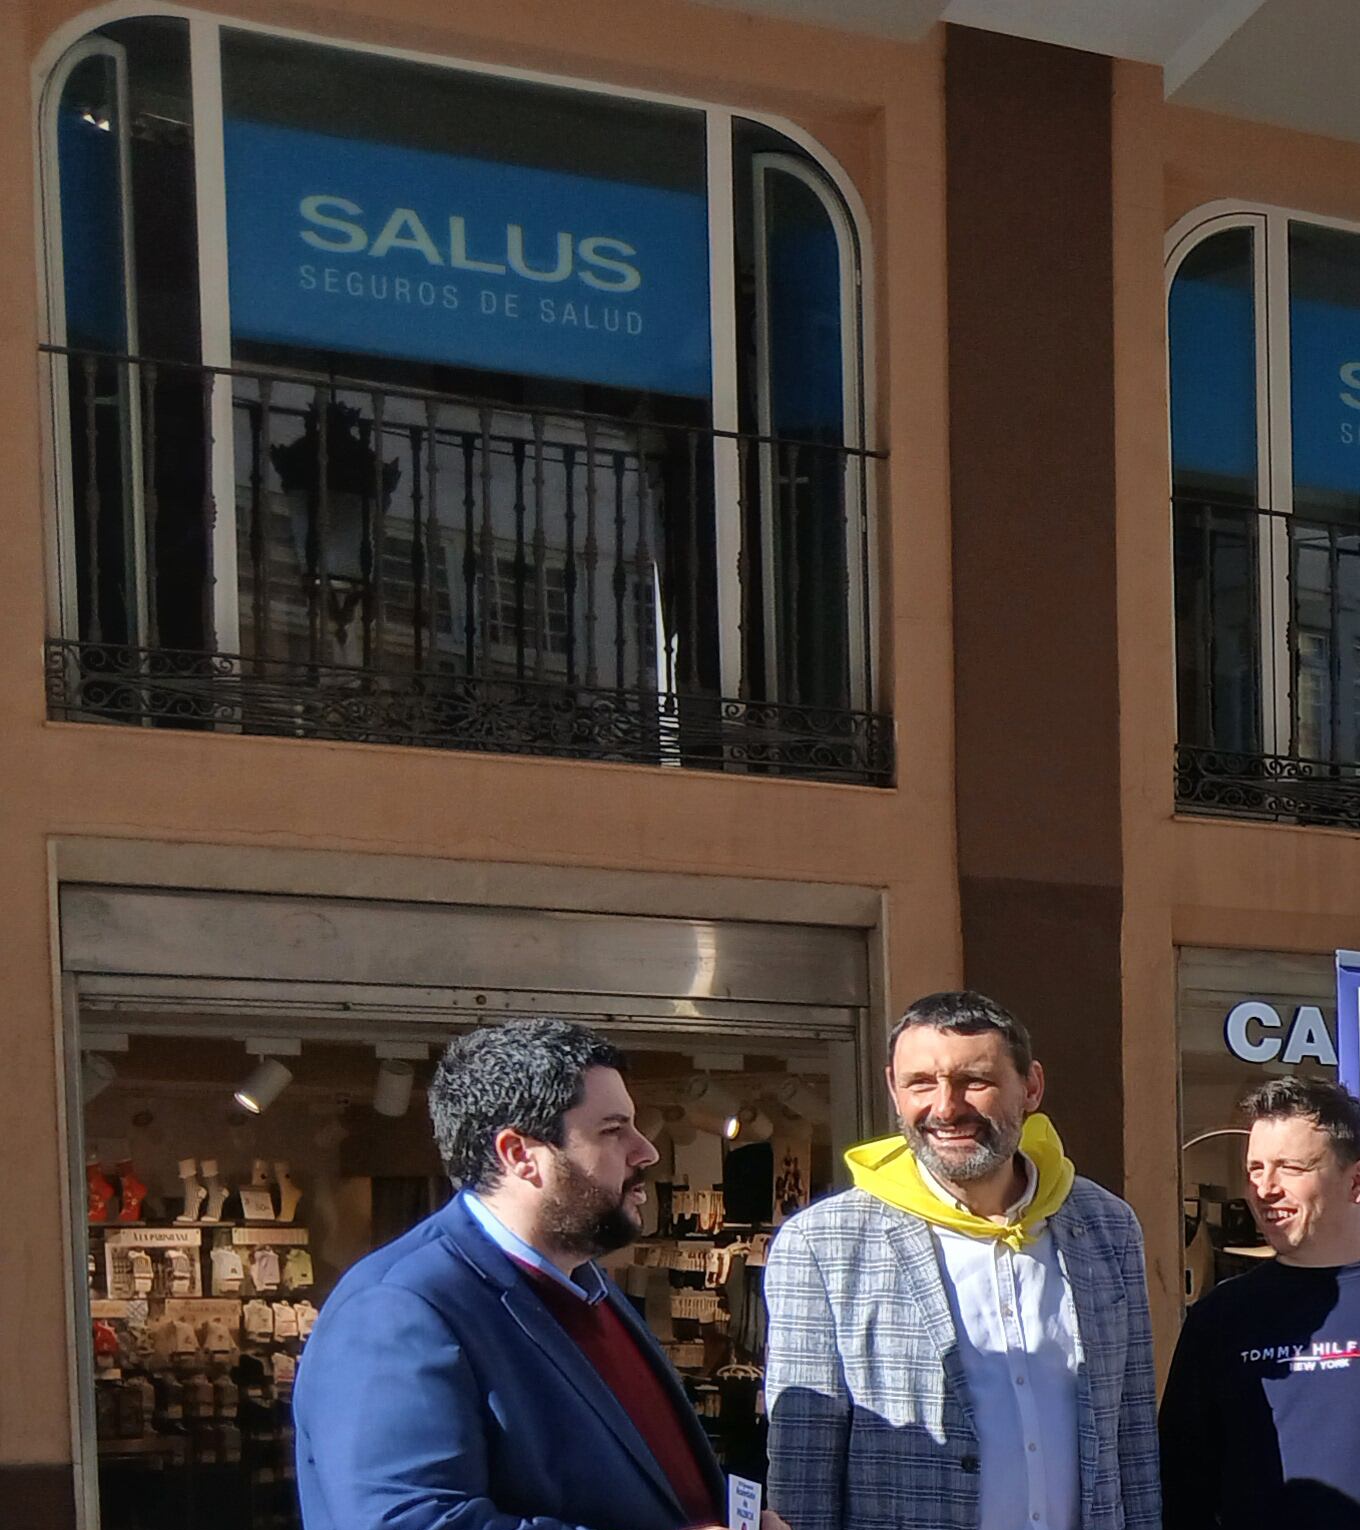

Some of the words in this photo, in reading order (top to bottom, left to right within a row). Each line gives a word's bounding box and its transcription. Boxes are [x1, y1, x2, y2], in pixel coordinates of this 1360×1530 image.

[300, 195, 642, 292] SALUS
[300, 264, 459, 310] SEGUROS
[481, 290, 519, 318] DE
[540, 299, 643, 335] SALUD
[1240, 1344, 1304, 1363] TOMMY
